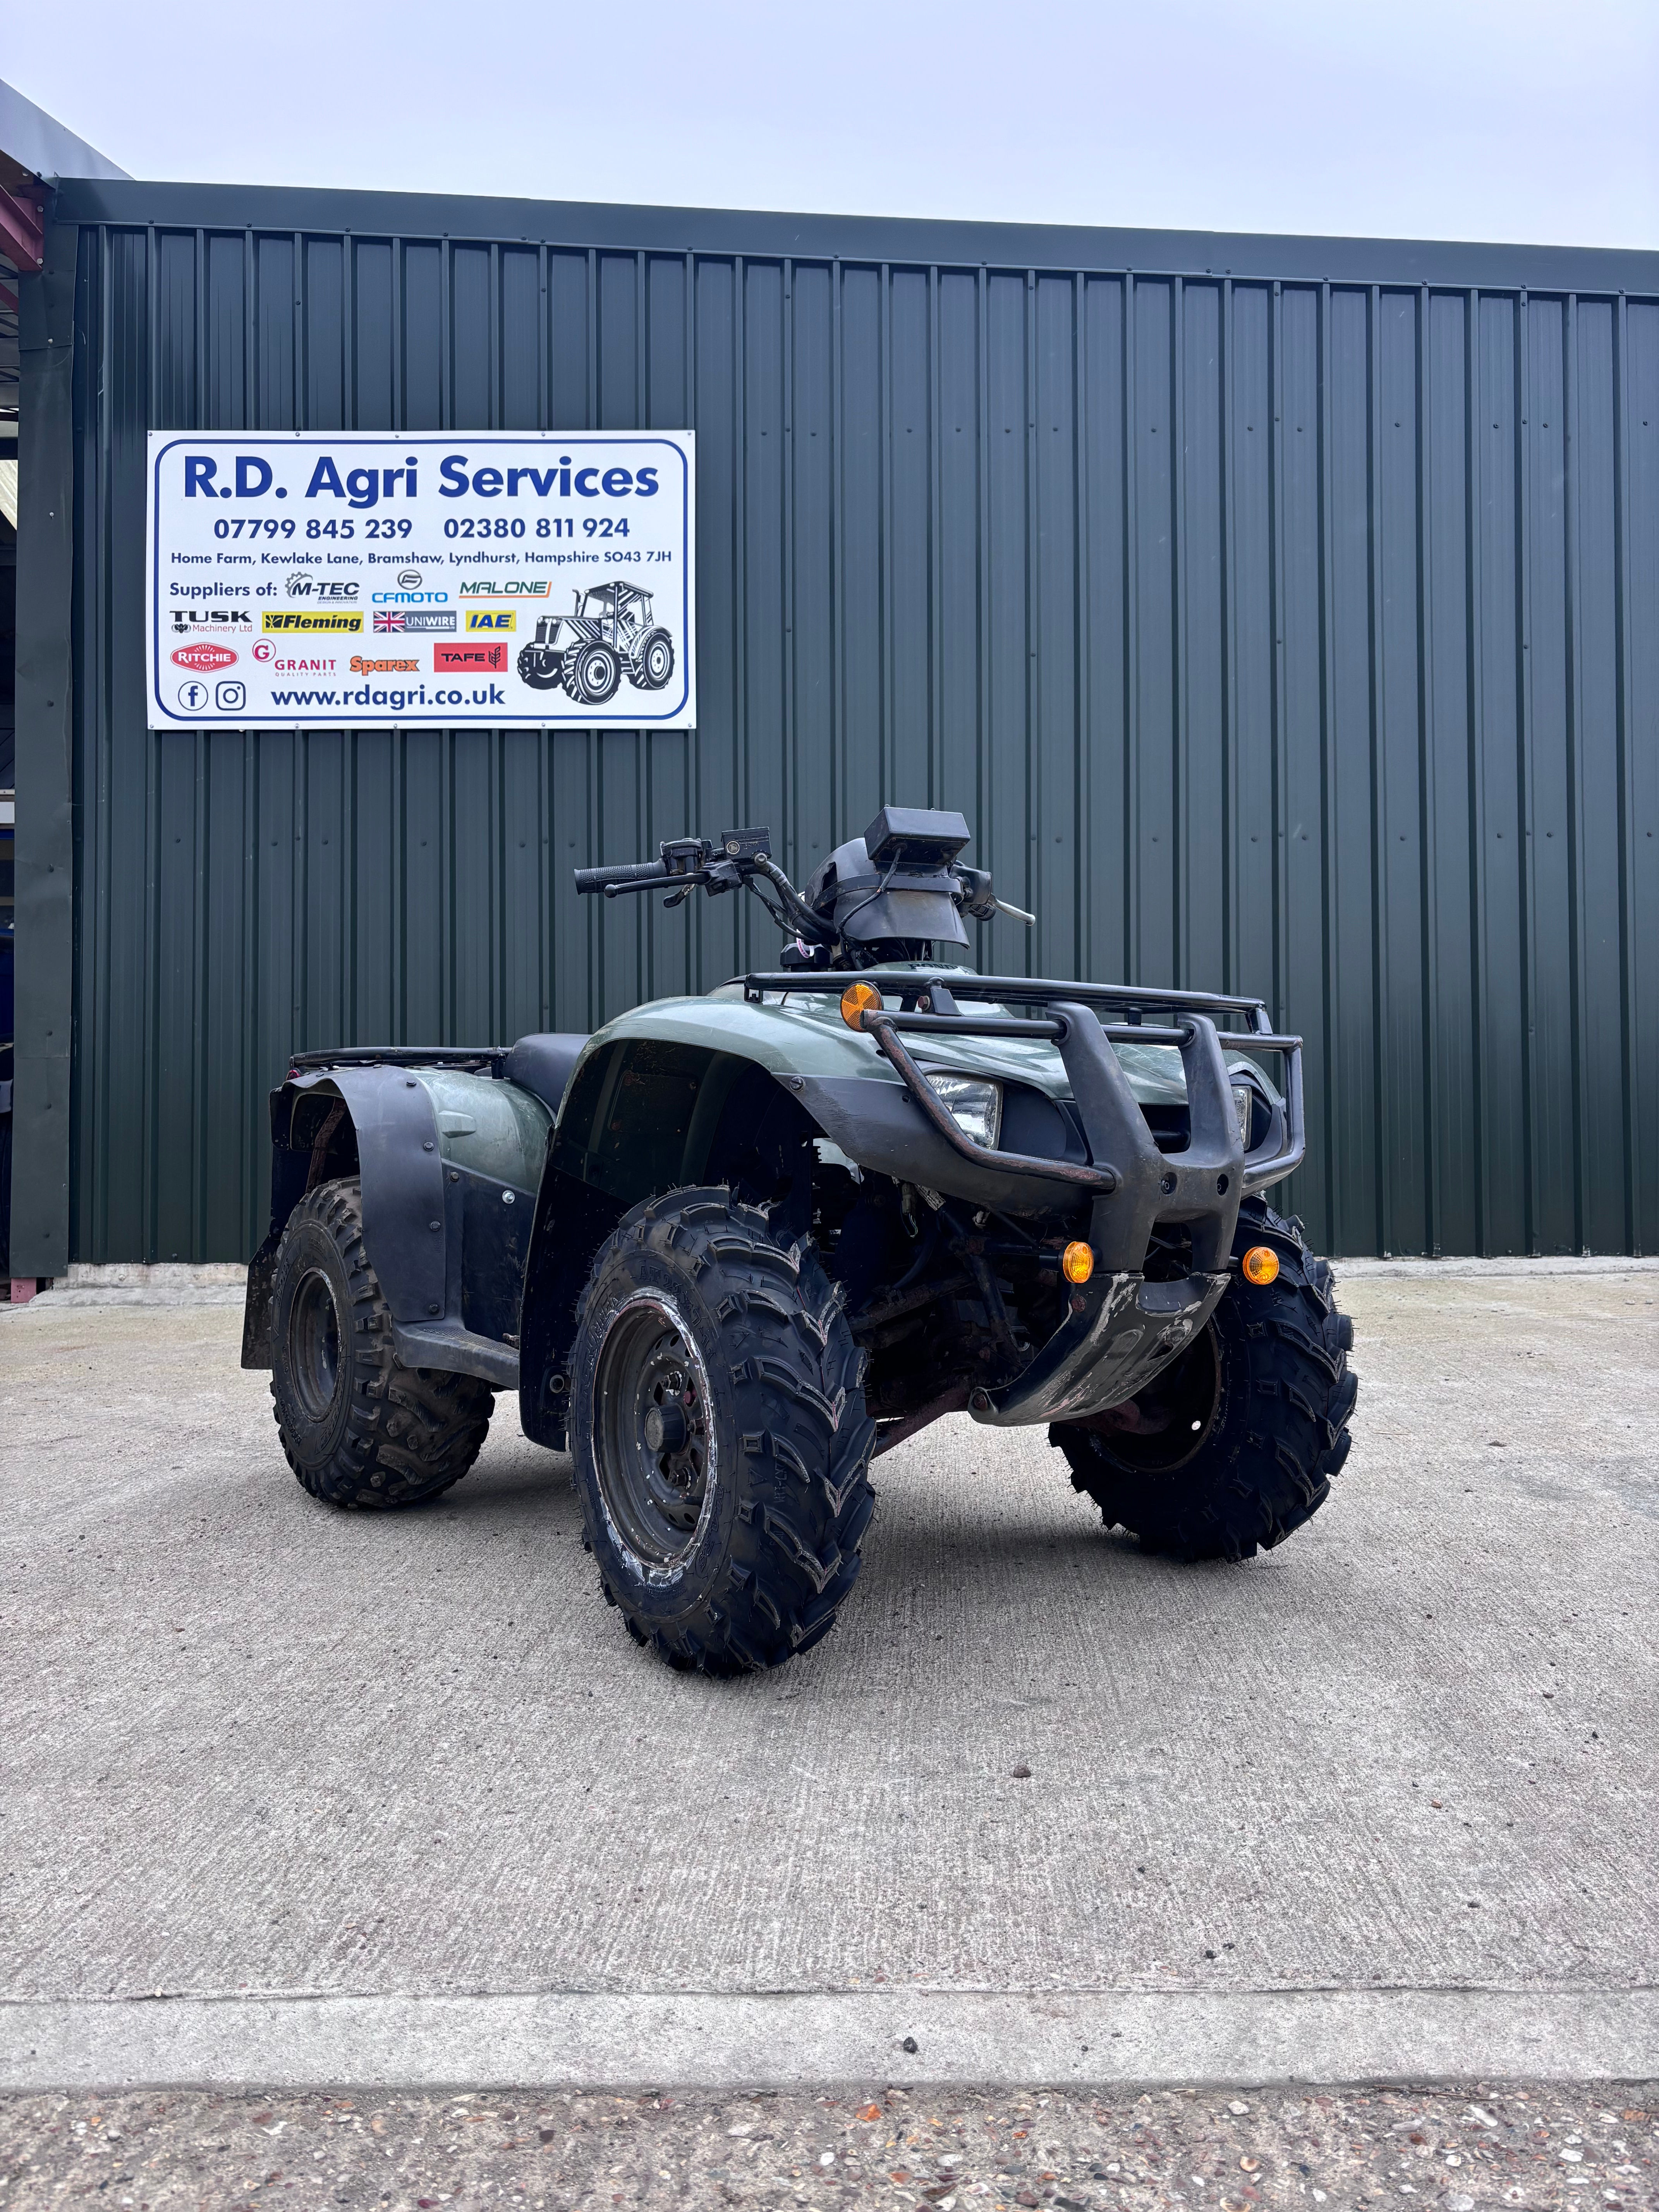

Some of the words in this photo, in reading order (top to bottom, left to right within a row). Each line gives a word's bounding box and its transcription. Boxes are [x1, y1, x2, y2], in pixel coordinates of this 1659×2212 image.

[185, 456, 287, 498] R.D.
[305, 456, 418, 509] Agri
[438, 455, 658, 498] Services
[214, 519, 295, 539] 07799
[306, 519, 354, 539] 845
[365, 519, 412, 539] 239
[444, 518, 525, 538] 02380
[536, 518, 573, 538] 811
[583, 518, 630, 537] 924
[172, 553, 212, 563] Home
[217, 553, 256, 565] Farm,
[261, 552, 322, 563] Kewlake
[327, 553, 363, 565] Lane,
[368, 552, 444, 565] Bramshaw,
[449, 551, 520, 566] Lyndhurst,
[525, 551, 599, 565] Hampshire
[604, 551, 641, 562] SO43
[647, 551, 672, 562] 7JH
[170, 582, 250, 599] Suppliers
[256, 582, 277, 596] of:
[292, 582, 360, 596] M-TEC
[460, 581, 547, 594] MALONE
[372, 592, 448, 603] CFMOTO
[170, 611, 252, 622] TUSK
[283, 615, 361, 631] Fleming
[406, 616, 455, 626] UNIWIRE
[469, 614, 512, 628] IAE
[193, 624, 236, 633] Machinery
[178, 651, 231, 663] RITCHIE
[441, 653, 485, 662] TAFE
[275, 659, 336, 670] GRANIT
[350, 656, 420, 676] Sparex
[271, 684, 505, 710] www.rdagri.co.uk
